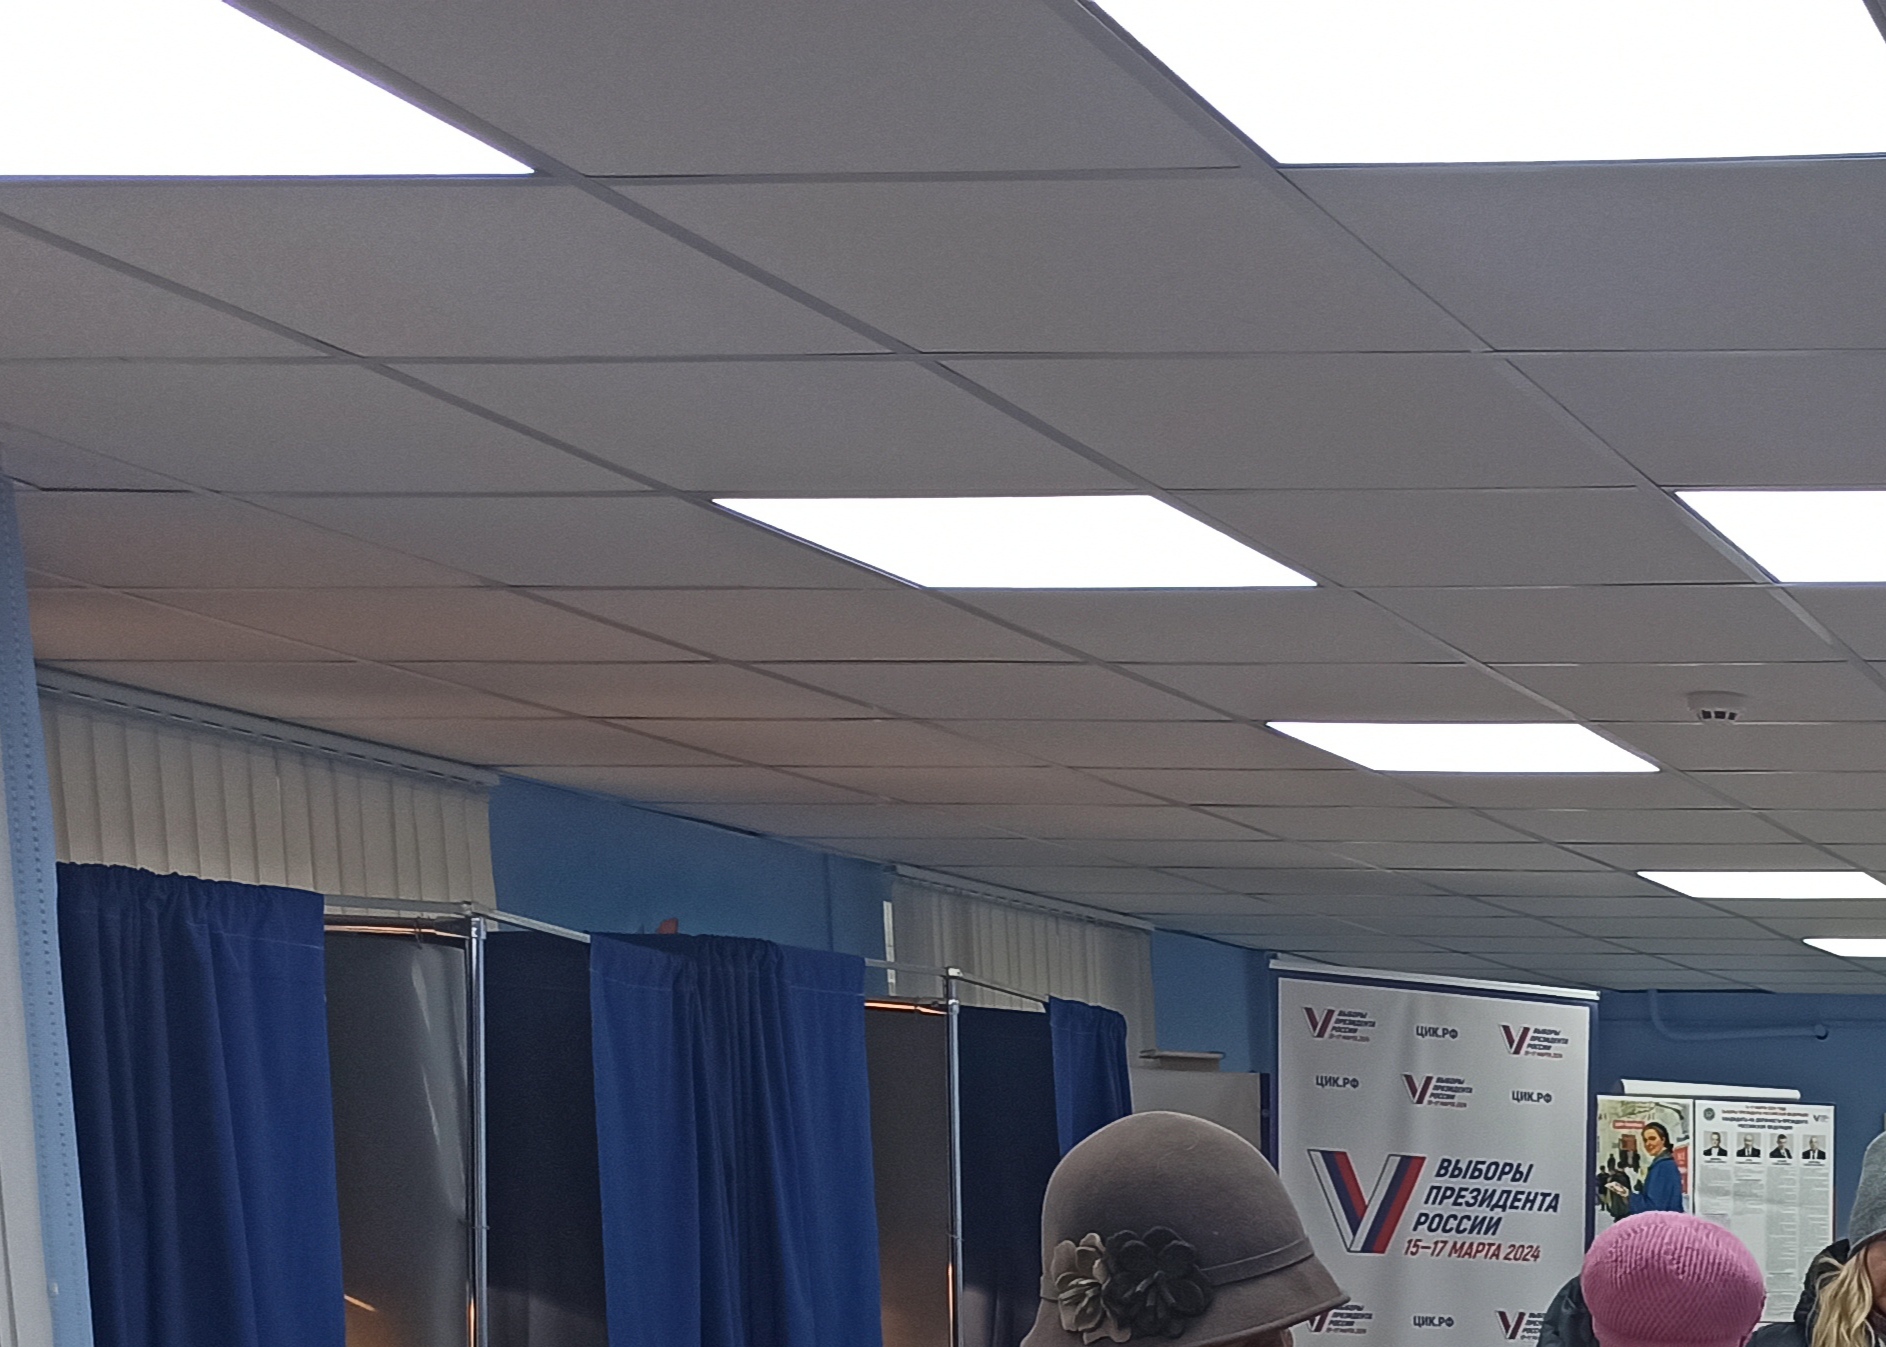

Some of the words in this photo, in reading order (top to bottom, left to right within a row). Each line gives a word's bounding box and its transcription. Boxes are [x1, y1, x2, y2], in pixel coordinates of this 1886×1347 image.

[1435, 1158, 1534, 1184] ВЫБОРЫ
[1424, 1185, 1560, 1213] ПРЕЗИДЕНТА
[1412, 1213, 1502, 1236] РОССИИ
[1448, 1241, 1502, 1260] МАРТА
[1503, 1244, 1541, 1262] 2024
